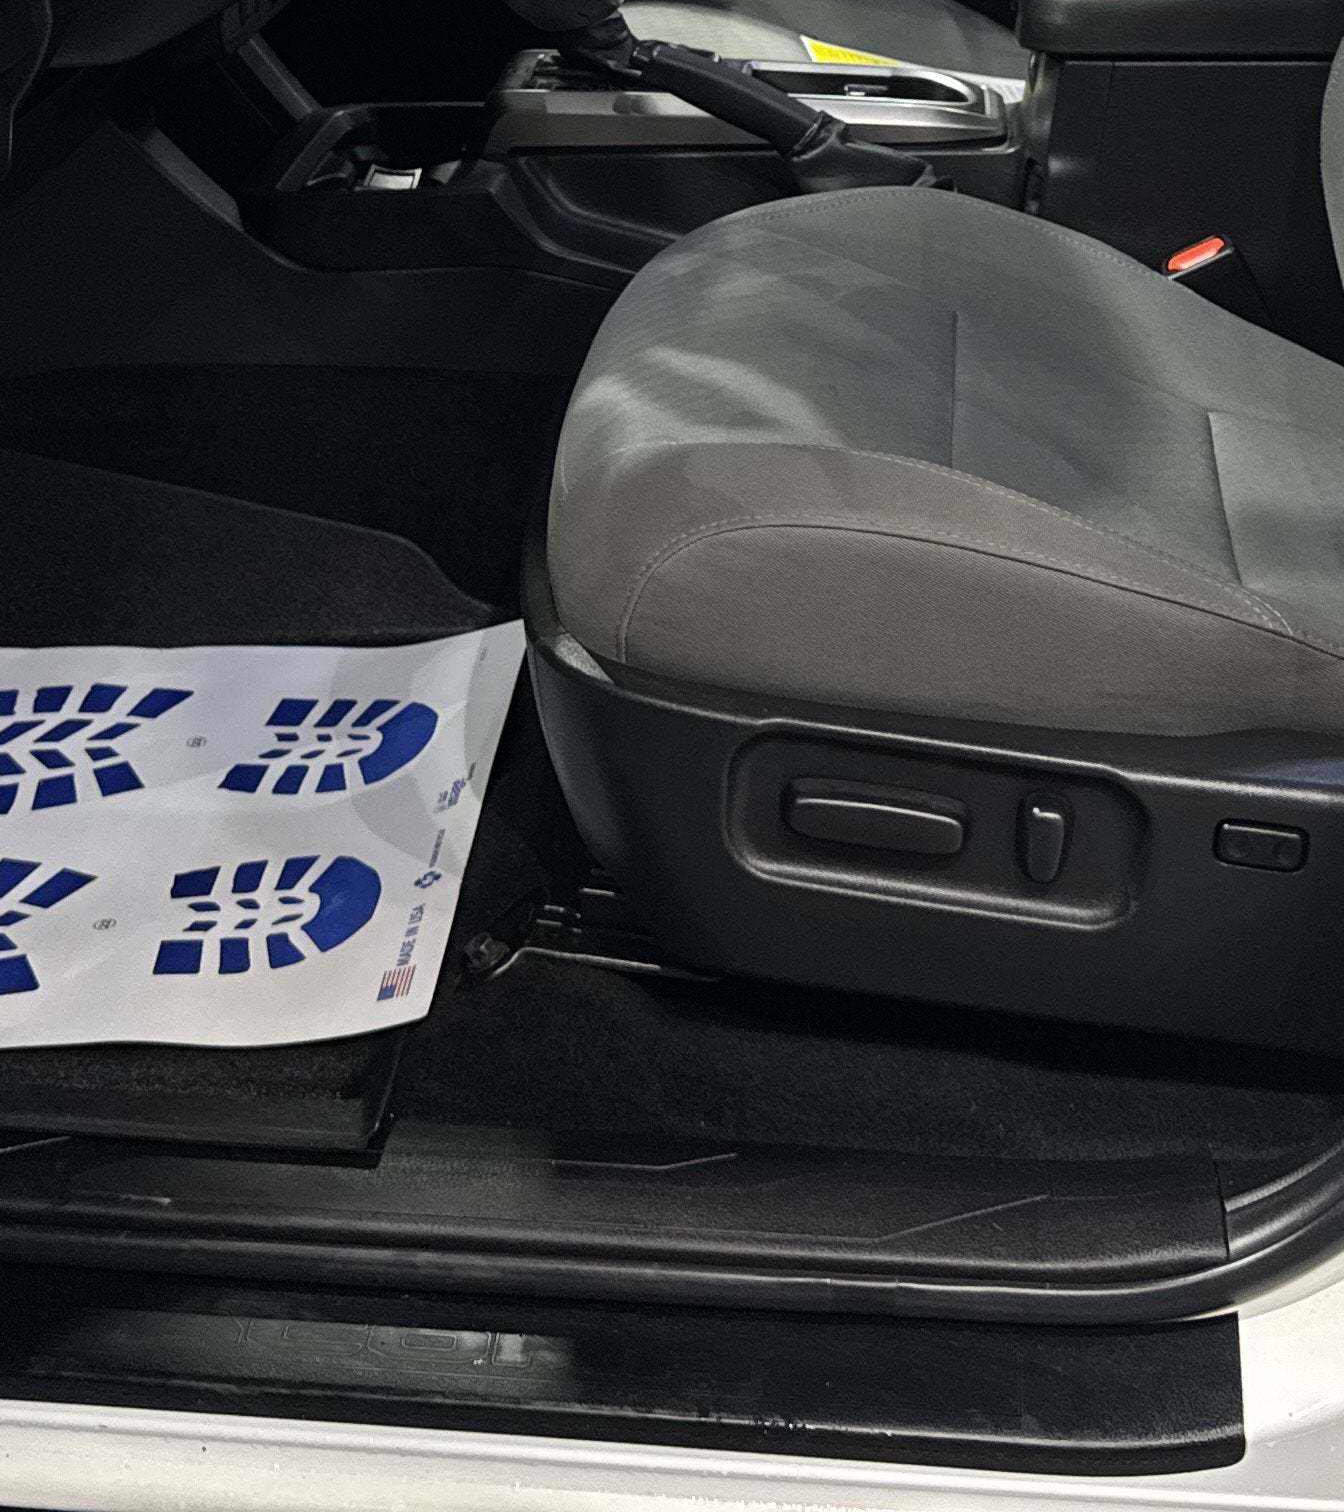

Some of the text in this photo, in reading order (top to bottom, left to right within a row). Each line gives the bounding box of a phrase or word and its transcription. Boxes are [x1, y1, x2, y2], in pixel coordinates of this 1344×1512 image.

[396, 903, 426, 967] MADE IN USA
